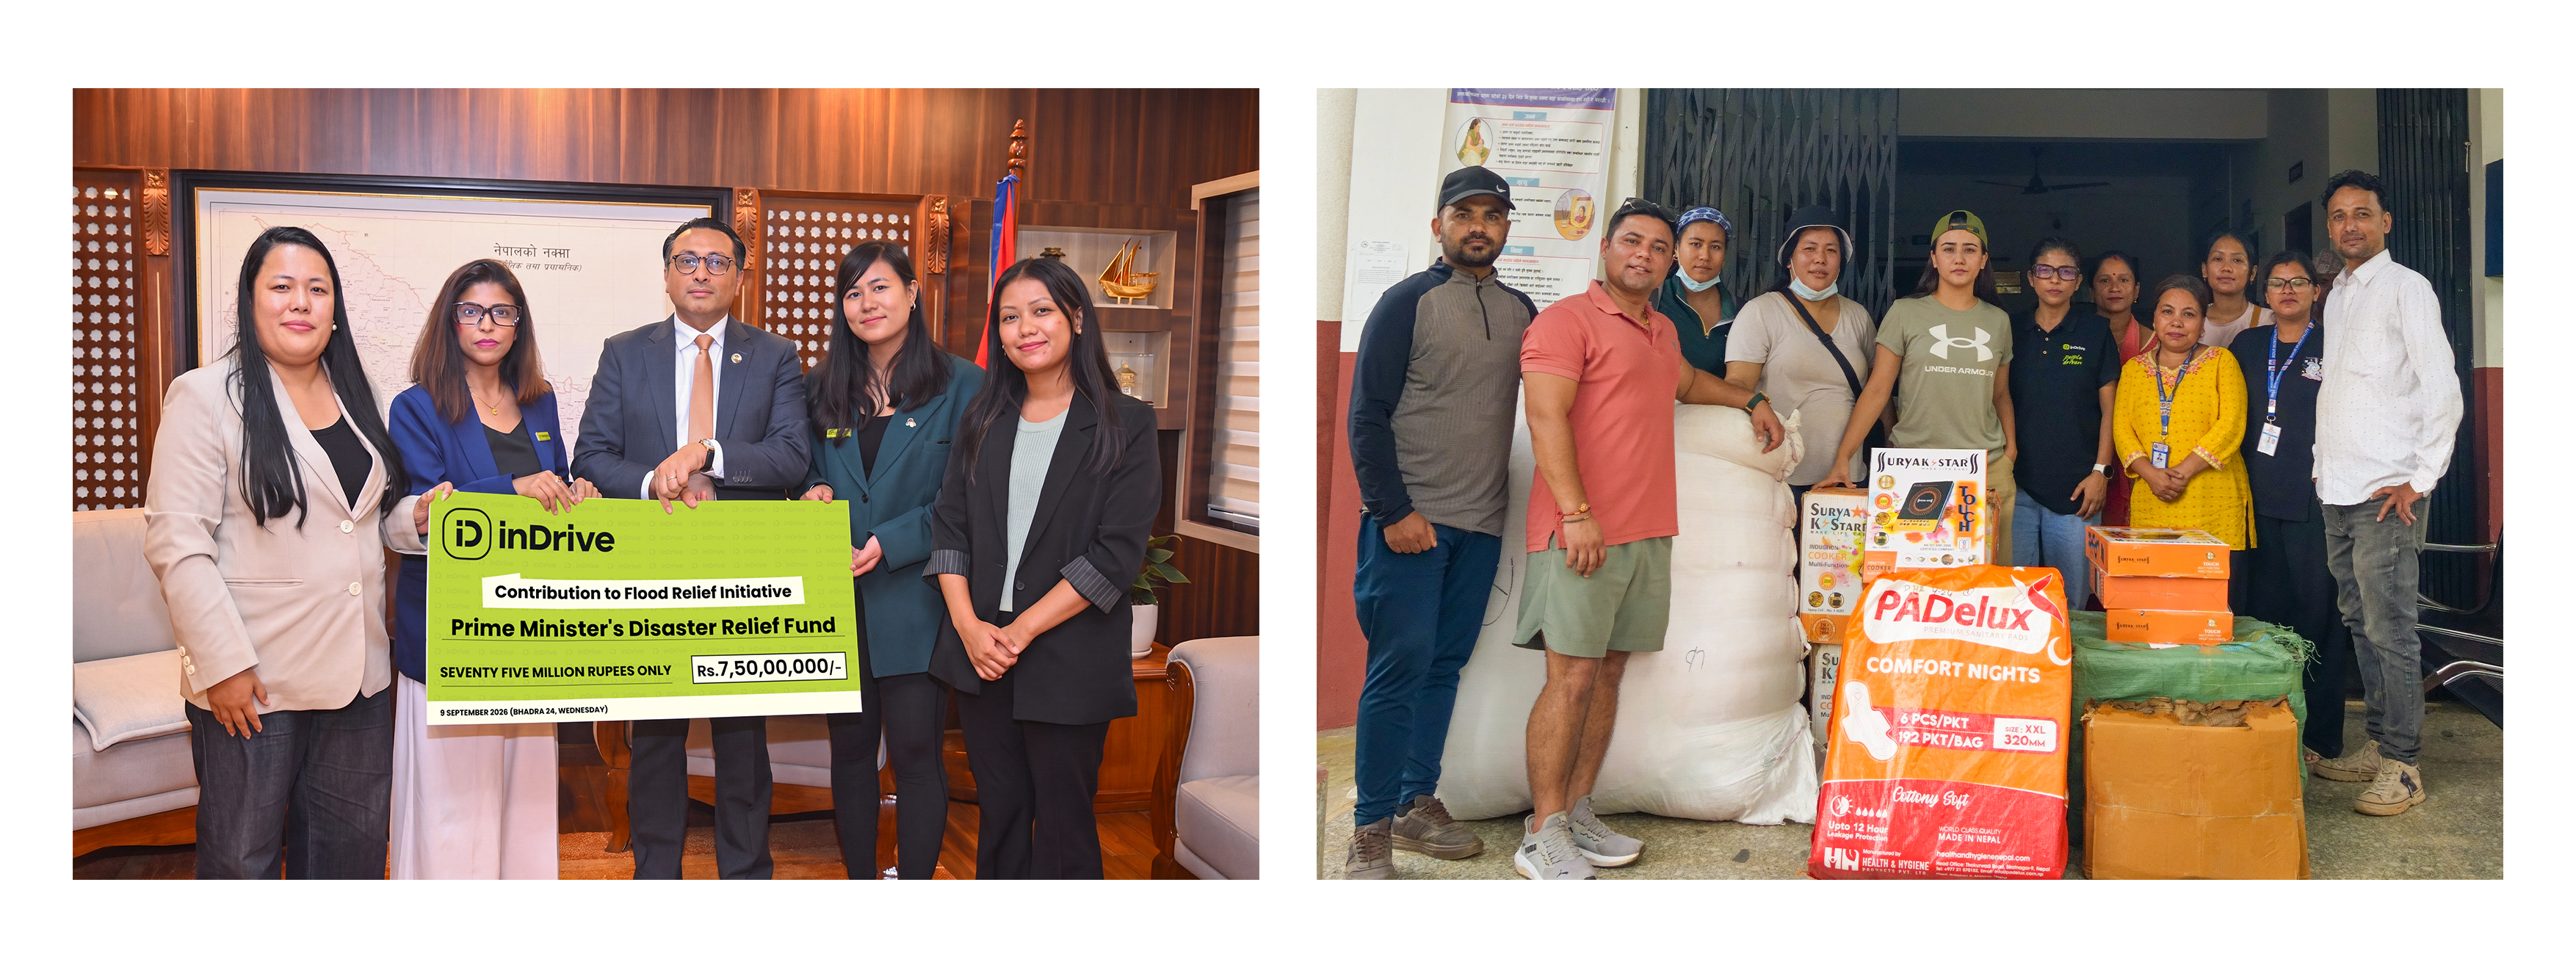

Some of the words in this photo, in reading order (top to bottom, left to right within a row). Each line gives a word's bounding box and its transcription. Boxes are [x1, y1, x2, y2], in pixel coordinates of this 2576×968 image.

[493, 242, 537, 257] नेपालको
[543, 248, 571, 259] नक्सा
[2295, 328, 2310, 350] MUNICIPALITY
[1925, 365, 1957, 374] UNDER
[1958, 368, 1994, 378] ARMOUR
[1811, 502, 1850, 520] SURYA
[1958, 485, 1977, 532] TOUCH
[499, 521, 615, 552] inDrive
[1809, 552, 1848, 561] COOKER
[496, 585, 600, 599] Contribution
[605, 588, 621, 599] to
[625, 587, 667, 599] Flood
[673, 585, 716, 599] Relief
[721, 585, 791, 598] Initiative
[1874, 590, 2034, 632] PADelux
[452, 618, 514, 637] Prime
[521, 619, 623, 637] Minister's
[631, 619, 717, 636] Disaster
[723, 617, 779, 635] Relief
[784, 617, 835, 633] Fund
[1924, 626, 1964, 635] PREMIUM
[1966, 629, 2005, 639] SANITARY
[2008, 633, 2028, 641] PADS
[441, 667, 498, 677] SEVENTY
[502, 668, 529, 677] FIVE
[532, 667, 584, 677] MILLION
[588, 666, 634, 676] RUPEES
[637, 665, 671, 675] ONLY
[698, 659, 841, 678] Rs.7,50,00,000/-
[1867, 657, 1964, 677] COMFORT
[1968, 664, 2041, 683] NIGHTS
[510, 708, 544, 716] (BHADRA
[559, 705, 607, 713] WEDNESDAY)
[1900, 713, 1909, 724] 6
[1911, 713, 1969, 729] PCS/PKT
[2025, 724, 2046, 734] XXL
[1898, 731, 1919, 743] 192
[1922, 732, 1983, 748] PKT/BAG
[2004, 734, 2046, 747] 320MM
[1892, 786, 1939, 807] Cottony
[1943, 790, 1970, 810] Soft
[1828, 820, 1850, 831] Upto
[1853, 823, 1864, 832] 12
[1867, 824, 1888, 834] Hour
[1827, 830, 1853, 839] Leakage
[1855, 832, 1888, 842] Protection
[1939, 833, 1962, 842] MADE
[1965, 834, 1974, 842] IN
[1977, 835, 2001, 844] NEPAL
[1524, 843, 1537, 855] PUMA
[1863, 848, 1894, 856] Manufactured
[1936, 850, 2030, 862] healthandhygienenepal.com
[1862, 857, 1889, 869] HEALTH
[1891, 860, 1896, 868] &
[1898, 859, 1930, 871] HYGIENE
